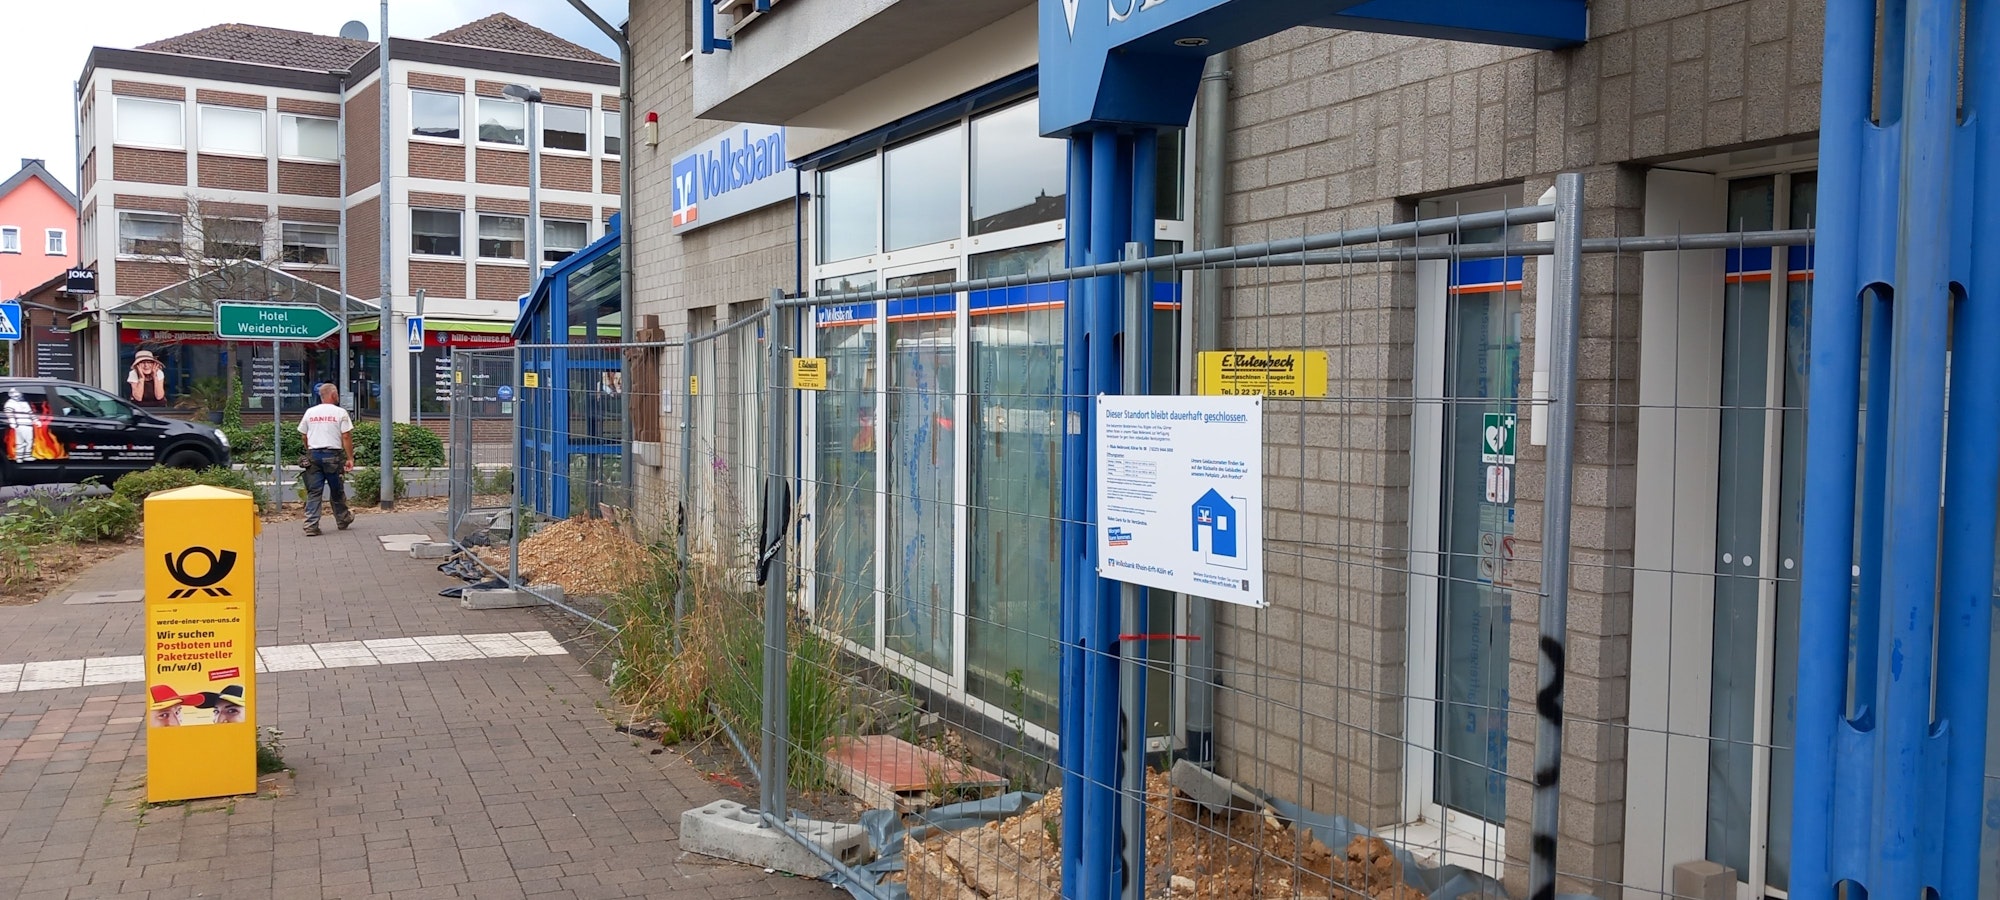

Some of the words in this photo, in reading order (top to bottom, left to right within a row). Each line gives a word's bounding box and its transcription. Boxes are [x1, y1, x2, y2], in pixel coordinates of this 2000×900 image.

[68, 270, 94, 279] JOKA
[259, 310, 288, 321] Hotel
[238, 323, 309, 335] Weidenbrück
[1222, 354, 1232, 367] E.
[1106, 410, 1123, 418] Dieser
[1125, 410, 1149, 419] Standort
[1150, 410, 1168, 420] bleibt
[1170, 411, 1202, 420] dauerhaft
[1204, 411, 1248, 423] geschlossen.
[1116, 560, 1135, 568] Volksbank
[1135, 563, 1167, 575] Rhein-Erft-Köln
[156, 617, 240, 625] werde-einer-von-uns.de
[157, 630, 175, 639] Wir
[178, 630, 214, 638] suchen
[157, 641, 210, 650] Postboten
[213, 640, 232, 648] und
[157, 651, 233, 661] Paketzusteller
[157, 662, 201, 673] (m/w/d)
